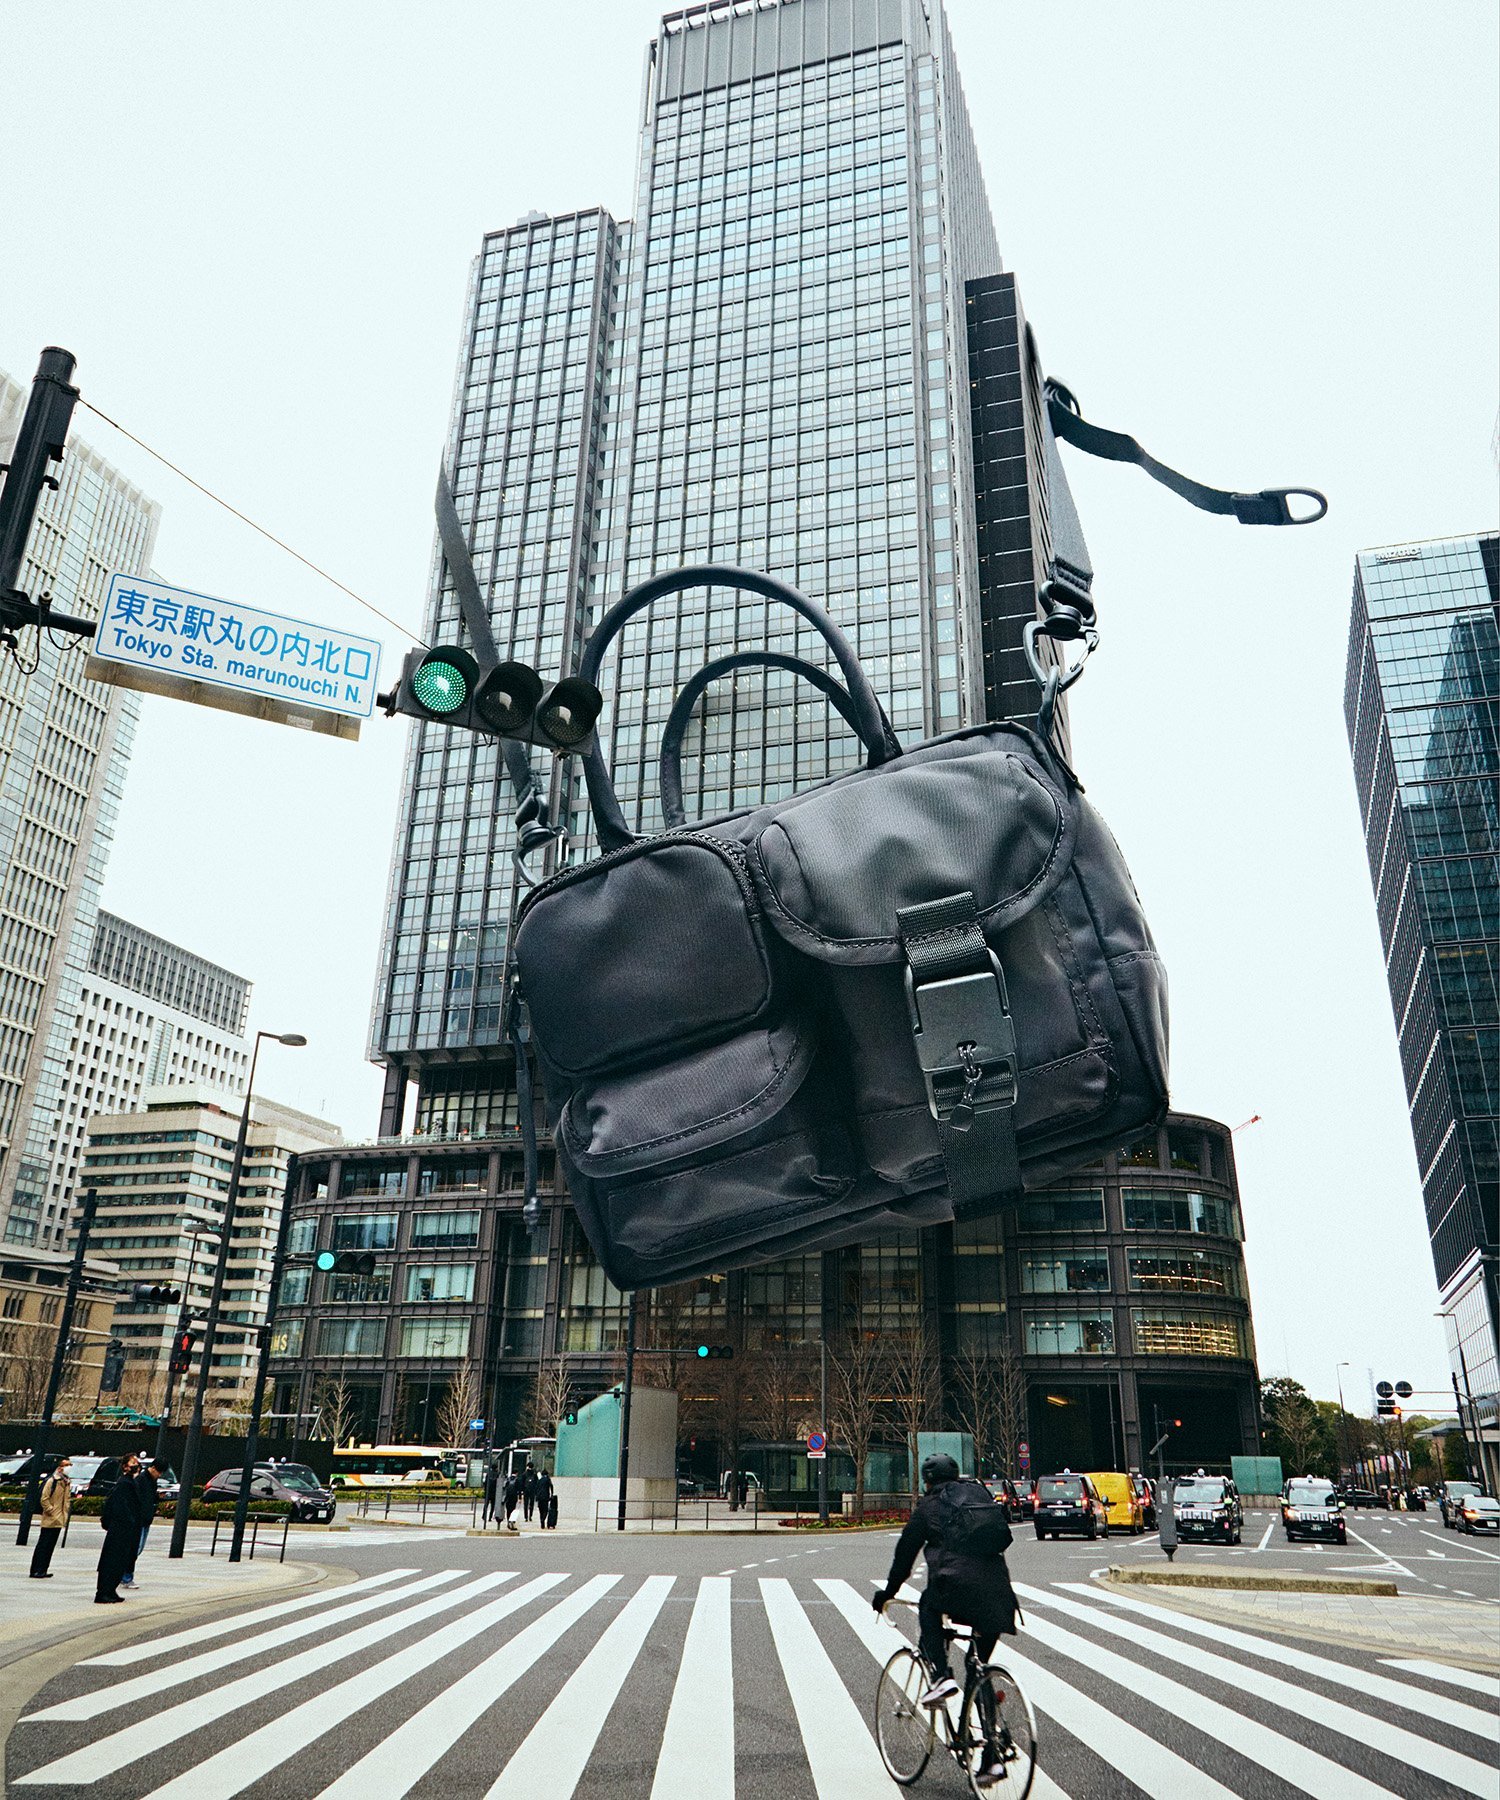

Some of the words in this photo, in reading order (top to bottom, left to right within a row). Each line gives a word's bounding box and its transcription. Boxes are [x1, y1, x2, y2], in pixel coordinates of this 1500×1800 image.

[110, 588, 372, 681] 東京駅丸の内北口
[113, 627, 173, 659] Tokyo
[181, 645, 218, 670] Sta.
[226, 659, 339, 699] marunouchi
[344, 684, 362, 704] N.
